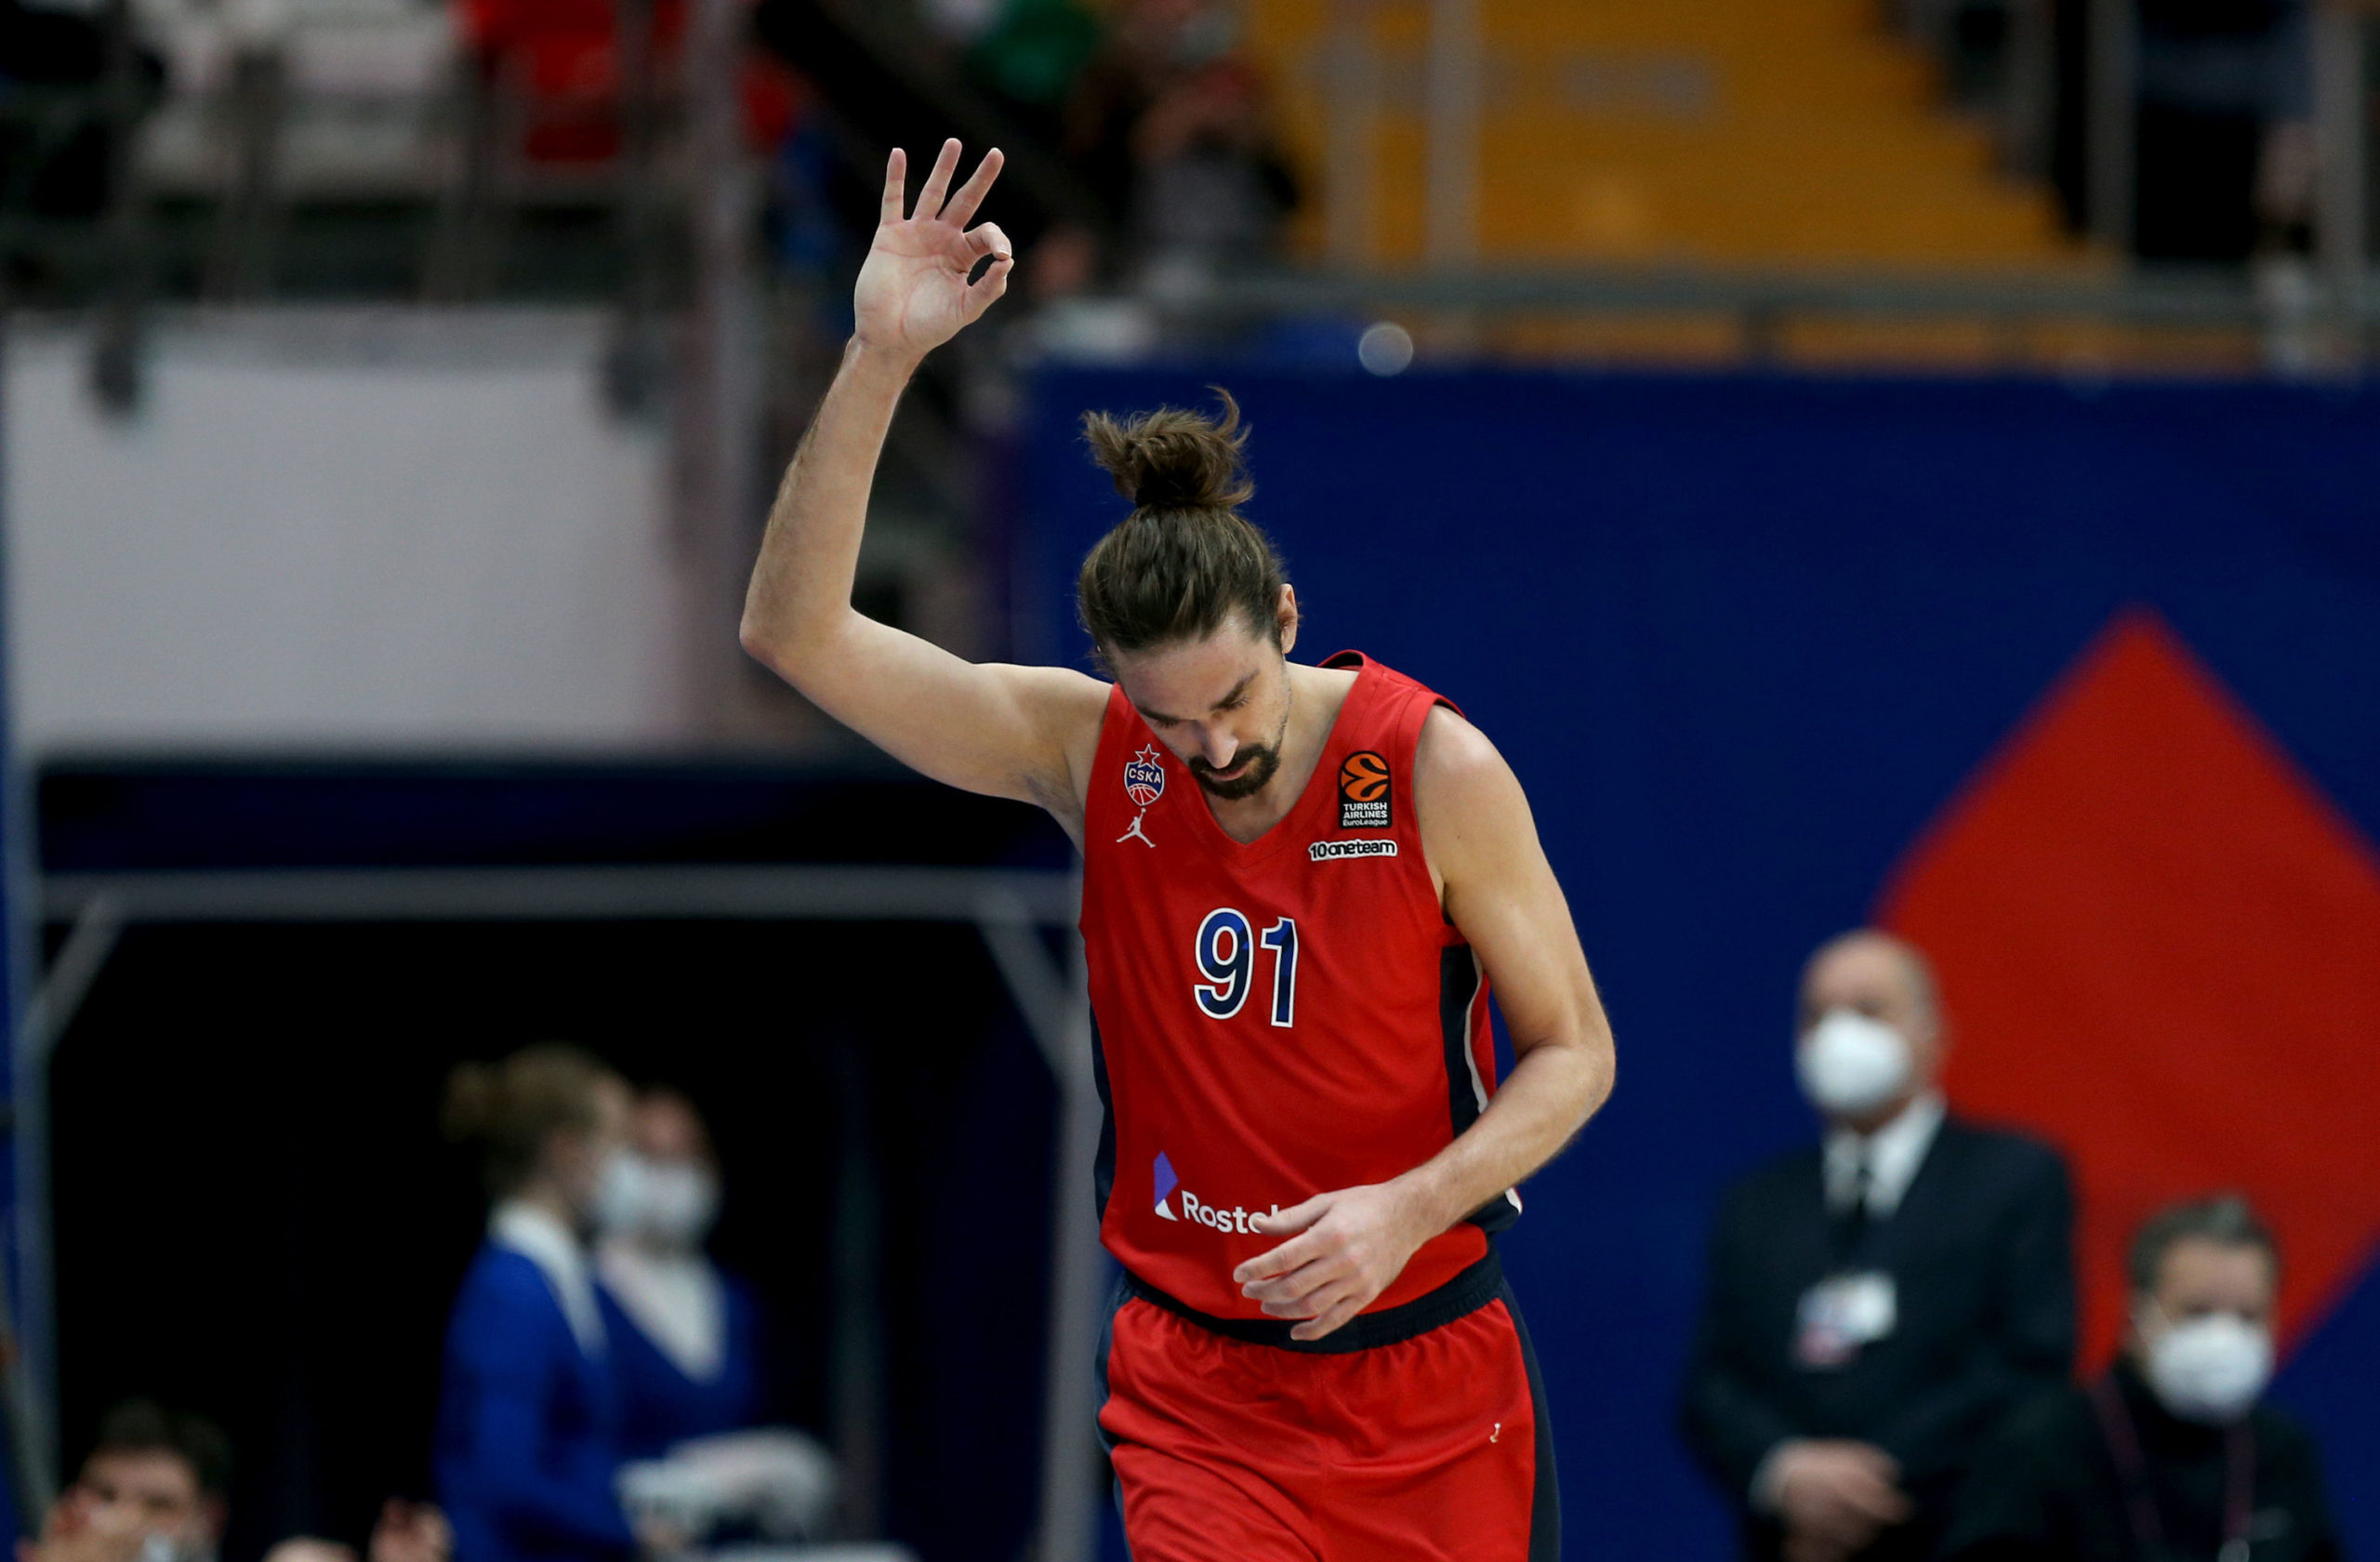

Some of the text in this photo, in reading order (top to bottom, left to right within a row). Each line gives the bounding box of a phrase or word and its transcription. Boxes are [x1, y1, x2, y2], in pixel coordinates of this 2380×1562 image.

[1129, 768, 1161, 784] CSKA
[1343, 802, 1387, 811] TURKISH
[1343, 810, 1388, 819] AIRLINES
[1342, 818, 1388, 827] EuroLeague
[1194, 907, 1299, 1028] 91
